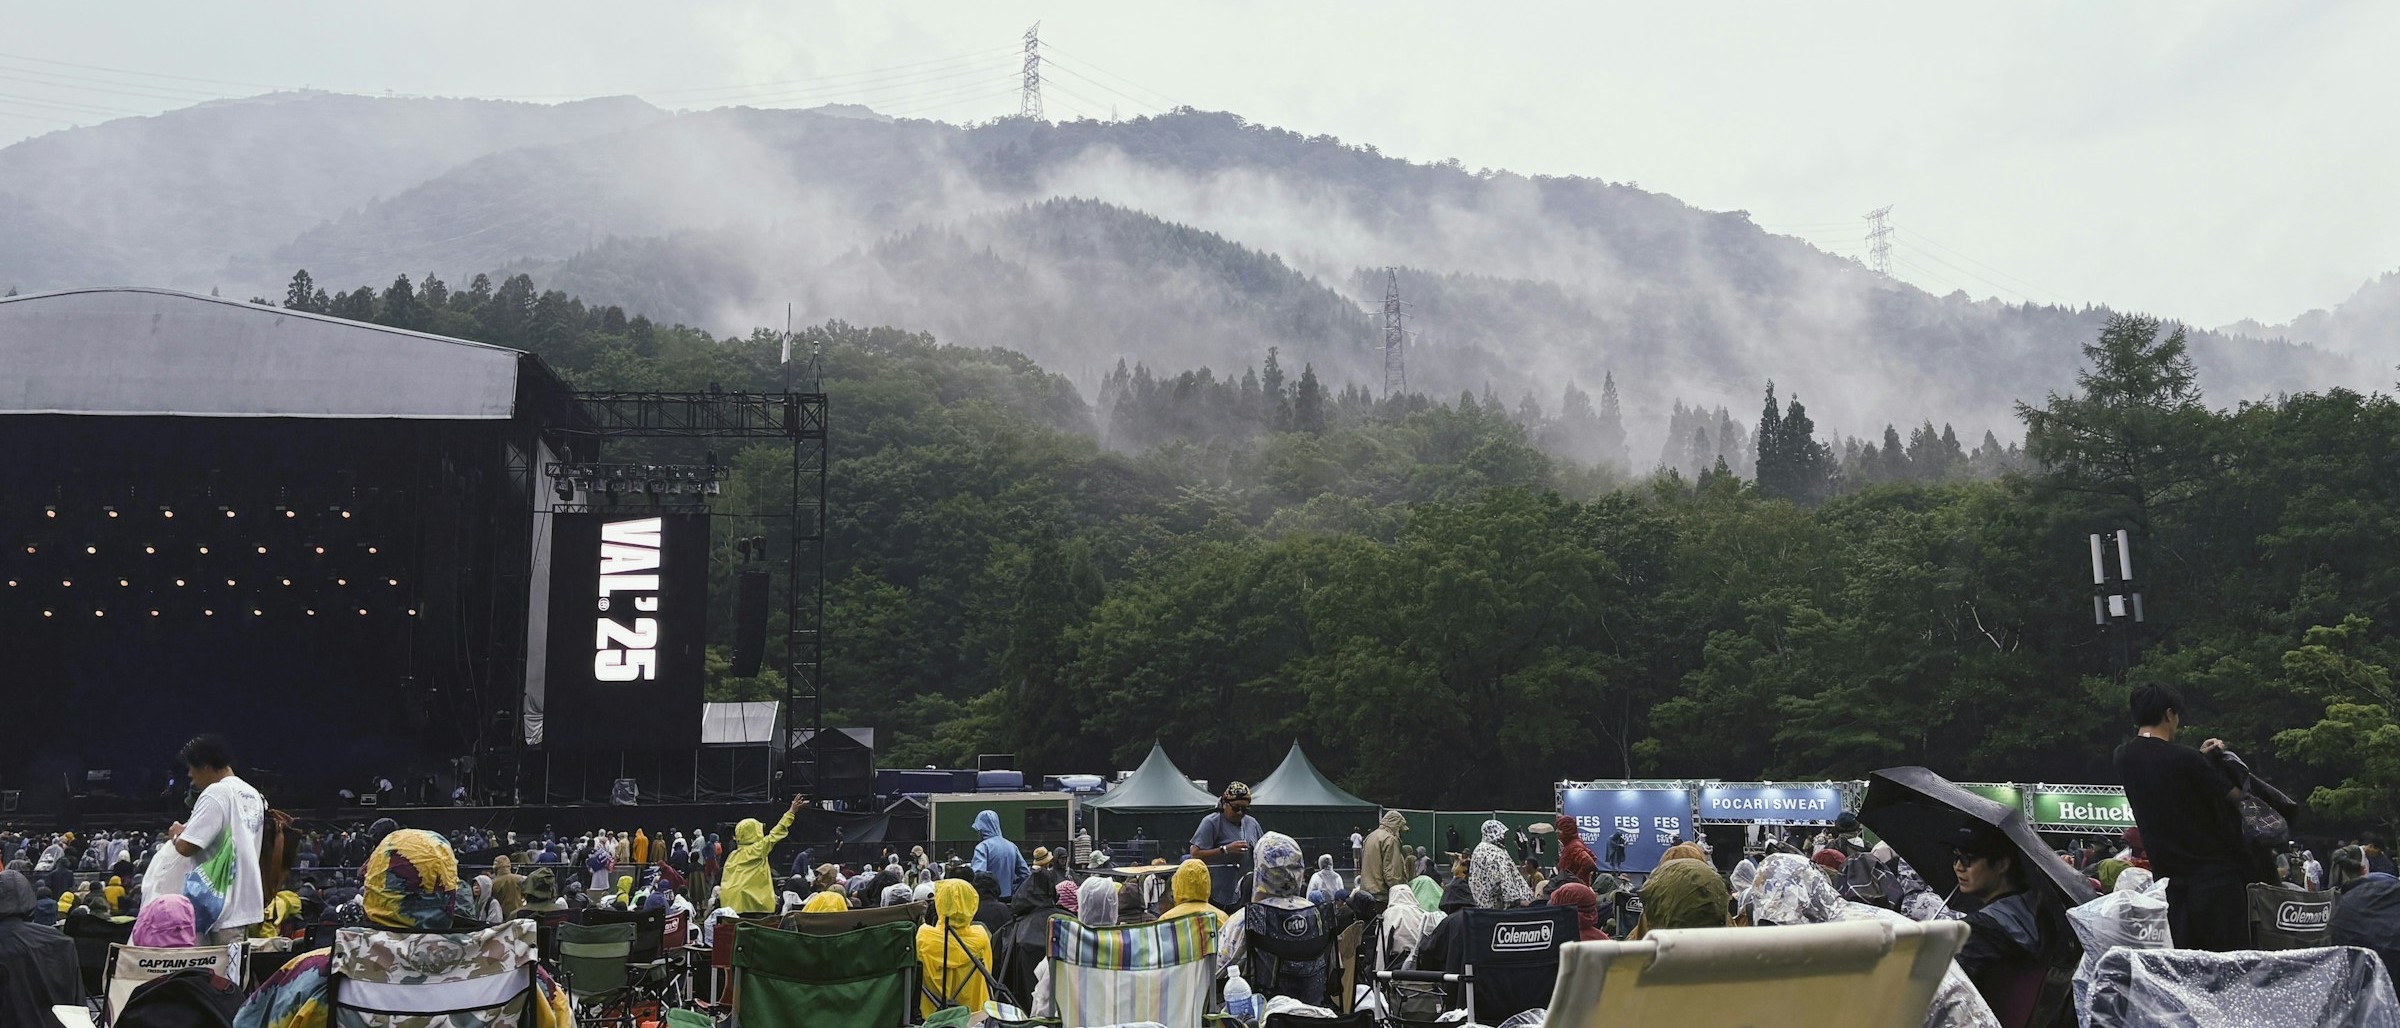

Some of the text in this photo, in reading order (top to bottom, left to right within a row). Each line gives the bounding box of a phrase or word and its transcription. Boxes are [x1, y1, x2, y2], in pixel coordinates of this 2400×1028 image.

[1712, 798, 1827, 810] POCARI SWEAT
[2058, 802, 2136, 822] Heinek
[1575, 815, 1600, 827] FES
[1614, 816, 1640, 828] FES
[1653, 816, 1680, 829] FES
[2281, 906, 2323, 924] Coleman
[1497, 926, 1541, 944] Coleman
[139, 955, 217, 968] CAPTAIN STAG
